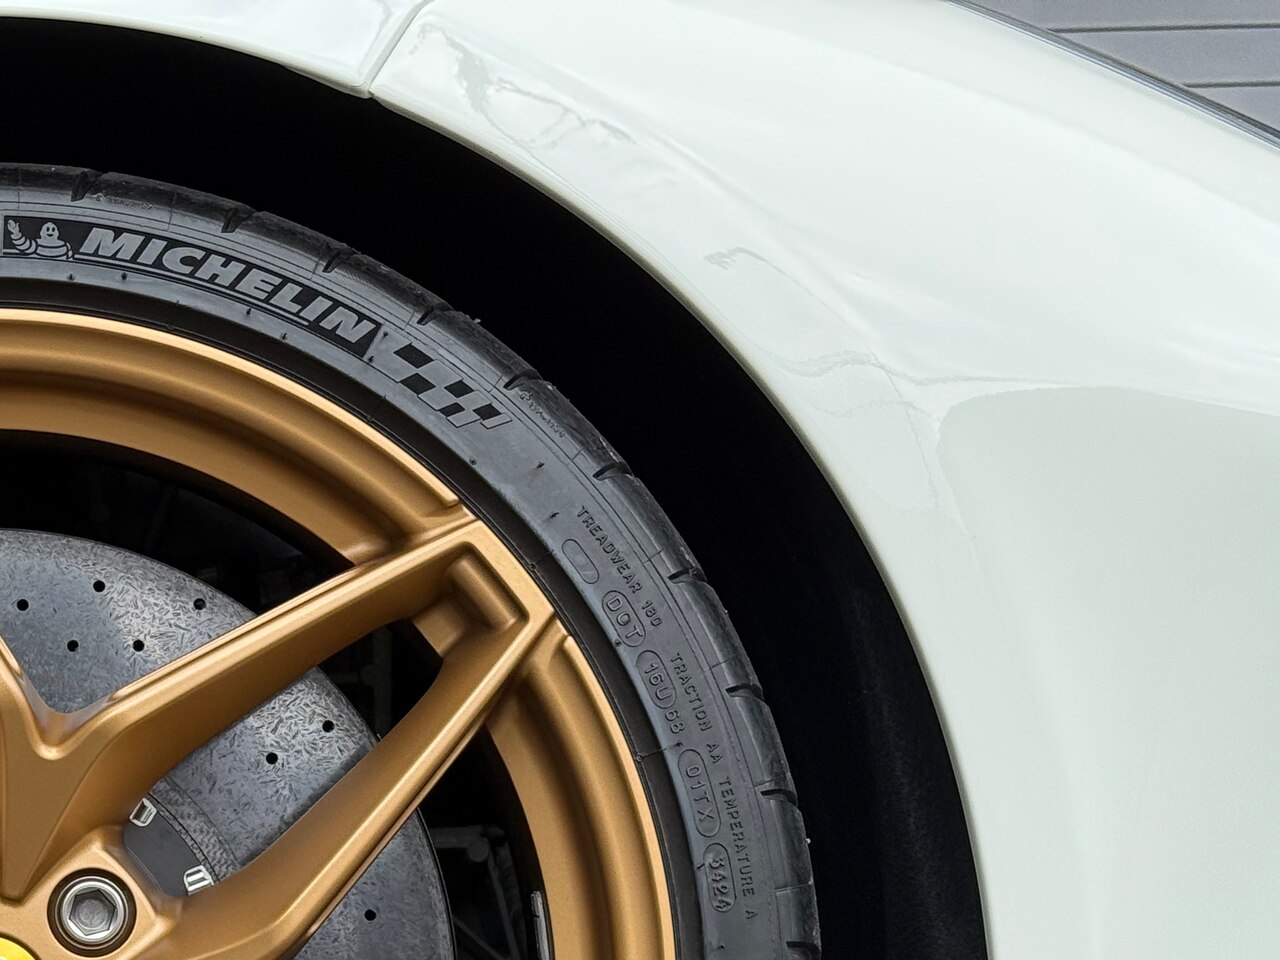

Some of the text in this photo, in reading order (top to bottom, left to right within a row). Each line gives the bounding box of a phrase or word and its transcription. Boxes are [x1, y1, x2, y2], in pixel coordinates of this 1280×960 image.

[82, 228, 375, 342] MICHELIN
[605, 593, 643, 641] DOT
[575, 506, 756, 920] TREADWEAR 180 TRACTION AA TEMPERATURE A
